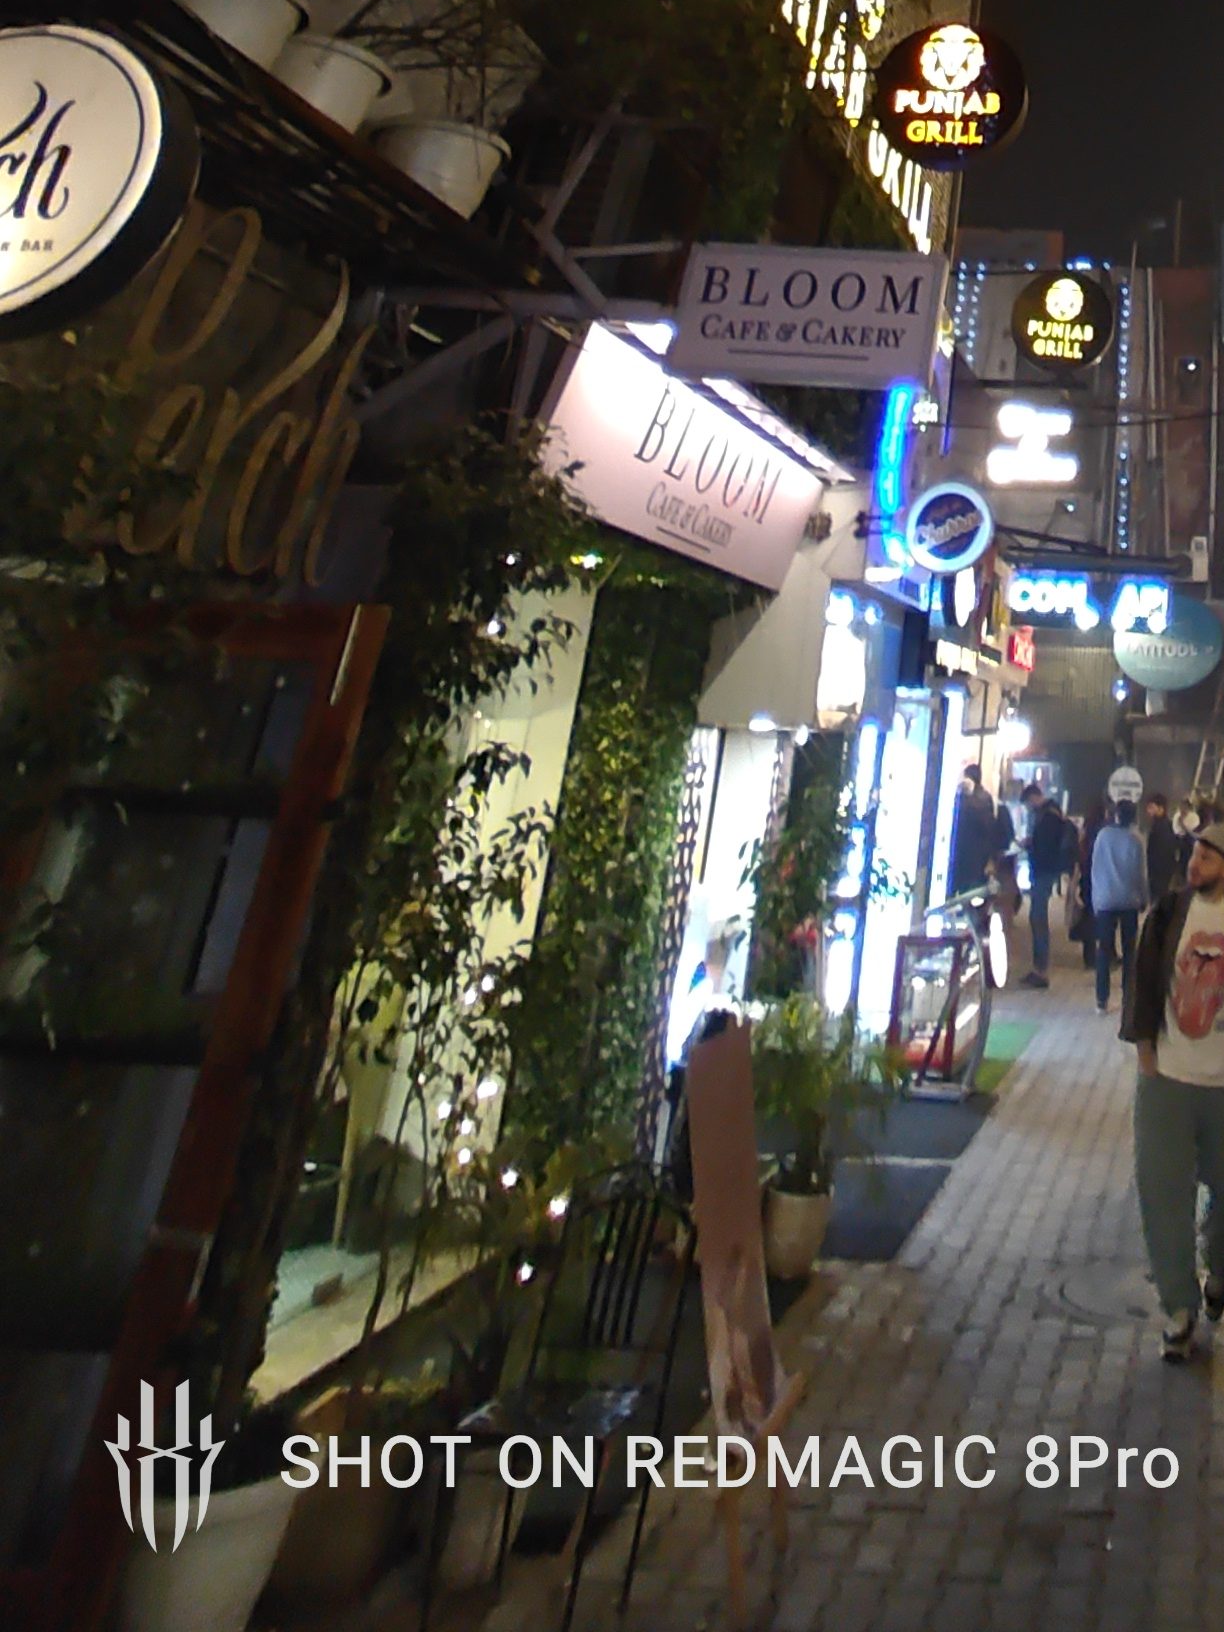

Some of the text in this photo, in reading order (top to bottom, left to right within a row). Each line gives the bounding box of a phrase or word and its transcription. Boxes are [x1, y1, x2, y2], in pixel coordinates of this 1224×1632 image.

[894, 89, 1001, 121] PUNJAB
[905, 120, 984, 145] GRILL
[699, 264, 925, 316] BLOOM
[700, 313, 772, 343] CAFE
[801, 318, 908, 350] CAKERY
[1028, 320, 1094, 346] PUNJAB
[1032, 339, 1083, 359] GRILL
[633, 384, 783, 526] BLOOM
